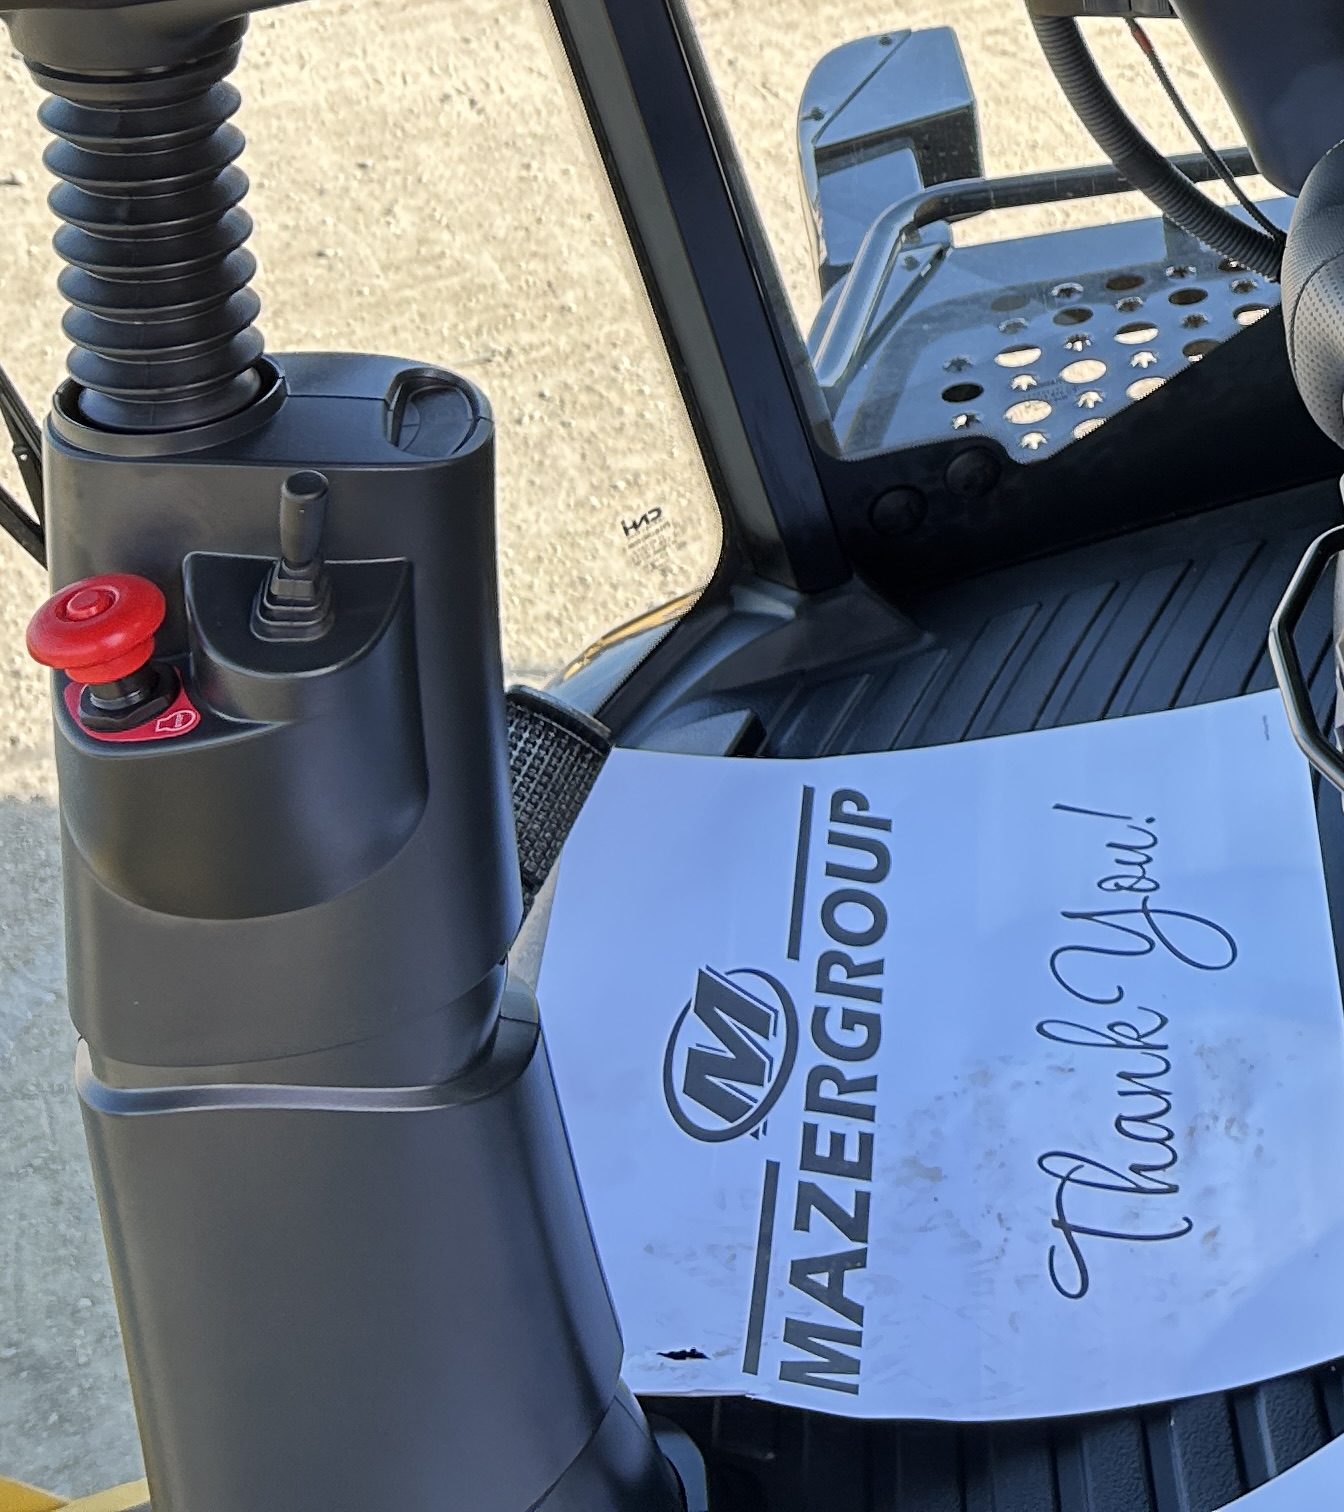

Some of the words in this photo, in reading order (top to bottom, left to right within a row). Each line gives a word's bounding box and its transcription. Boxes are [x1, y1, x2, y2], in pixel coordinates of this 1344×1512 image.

[1050, 803, 1238, 1004] You!
[779, 788, 892, 1396] MAZERGROUP
[1036, 1006, 1193, 1299] Thank
